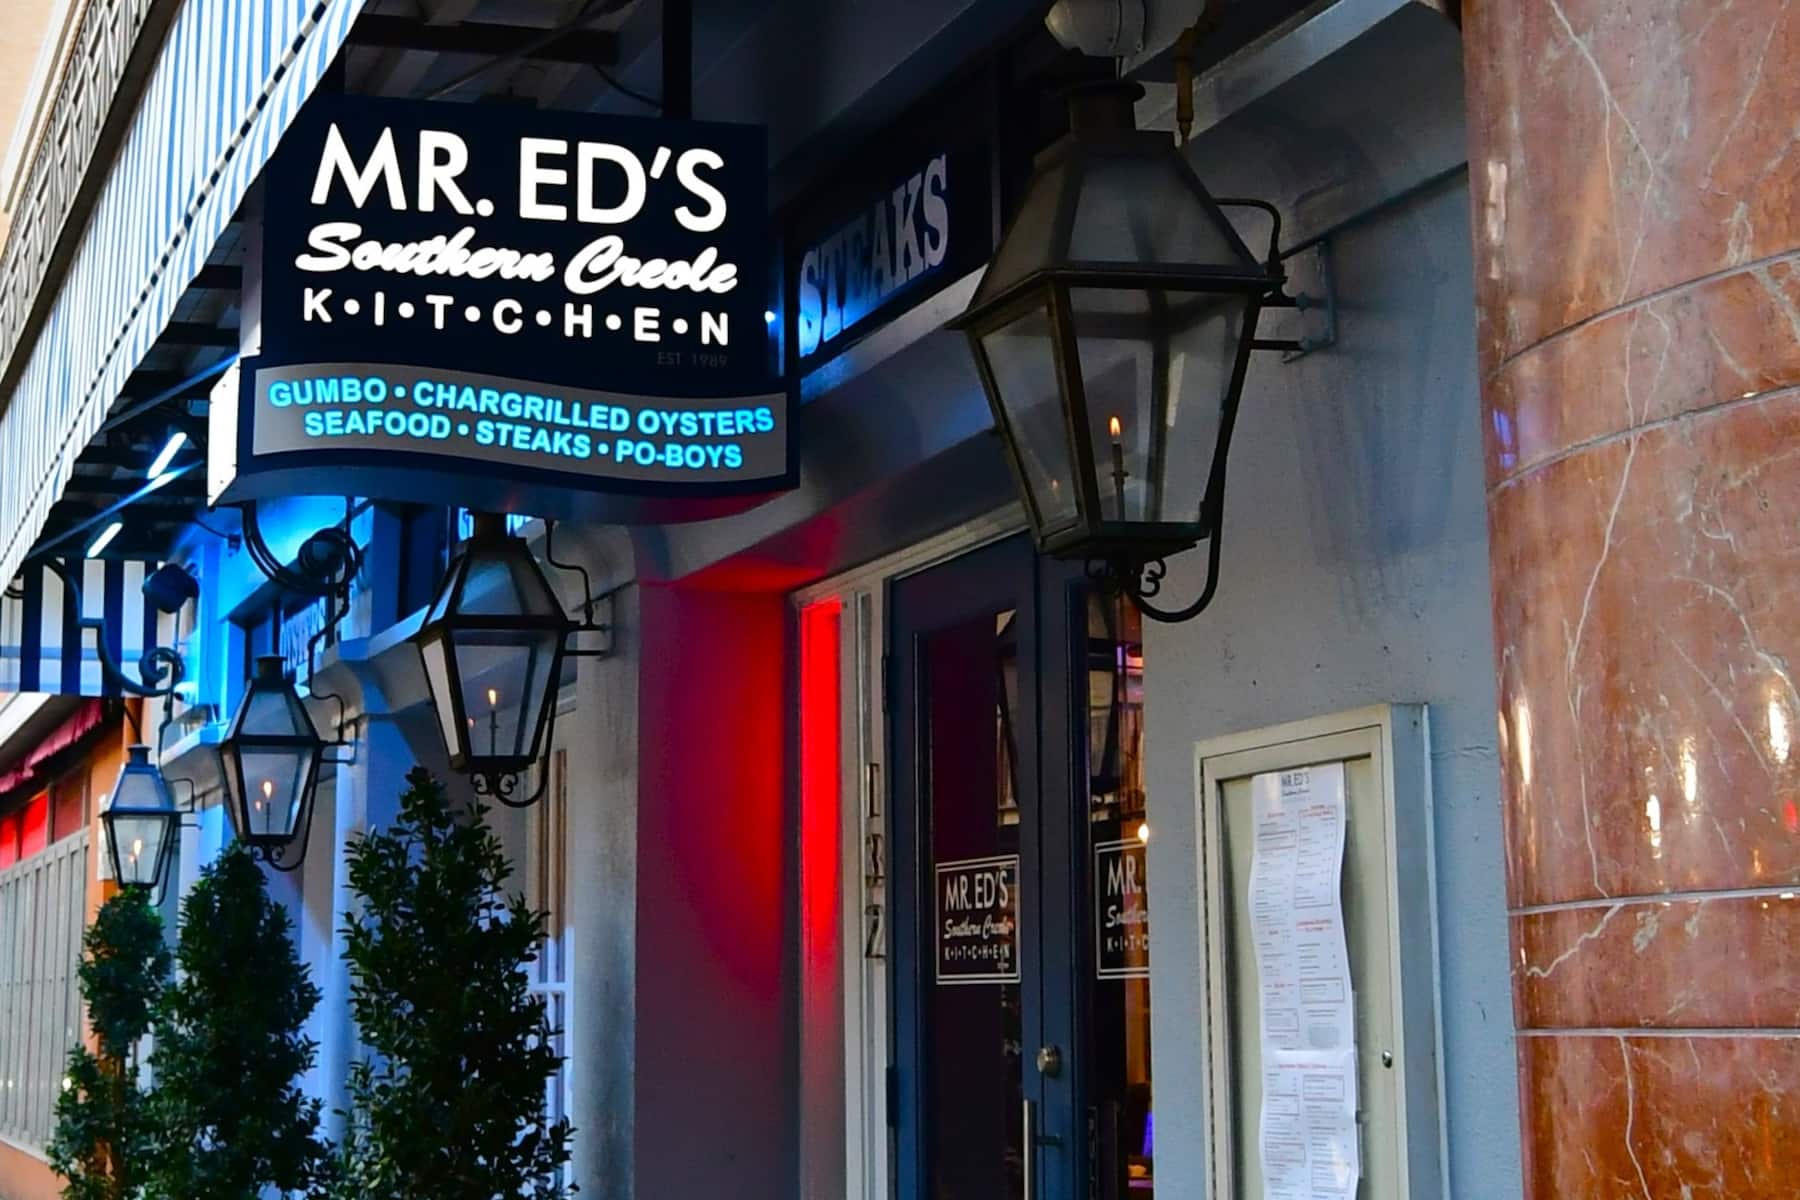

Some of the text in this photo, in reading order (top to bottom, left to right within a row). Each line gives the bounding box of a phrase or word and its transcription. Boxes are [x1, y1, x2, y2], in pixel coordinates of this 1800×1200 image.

[310, 122, 727, 232] MR. ED'S
[295, 222, 738, 295] Southern Creole
[799, 153, 948, 357] STEAKS
[656, 352, 682, 366] EST
[268, 377, 775, 437] GUMBO CHARGRILLED OYSTERS
[304, 409, 743, 469] SEAFOOD STEAKS PO-BOYS
[945, 870, 1009, 911] MR. ED'S
[1107, 855, 1142, 896] MR.
